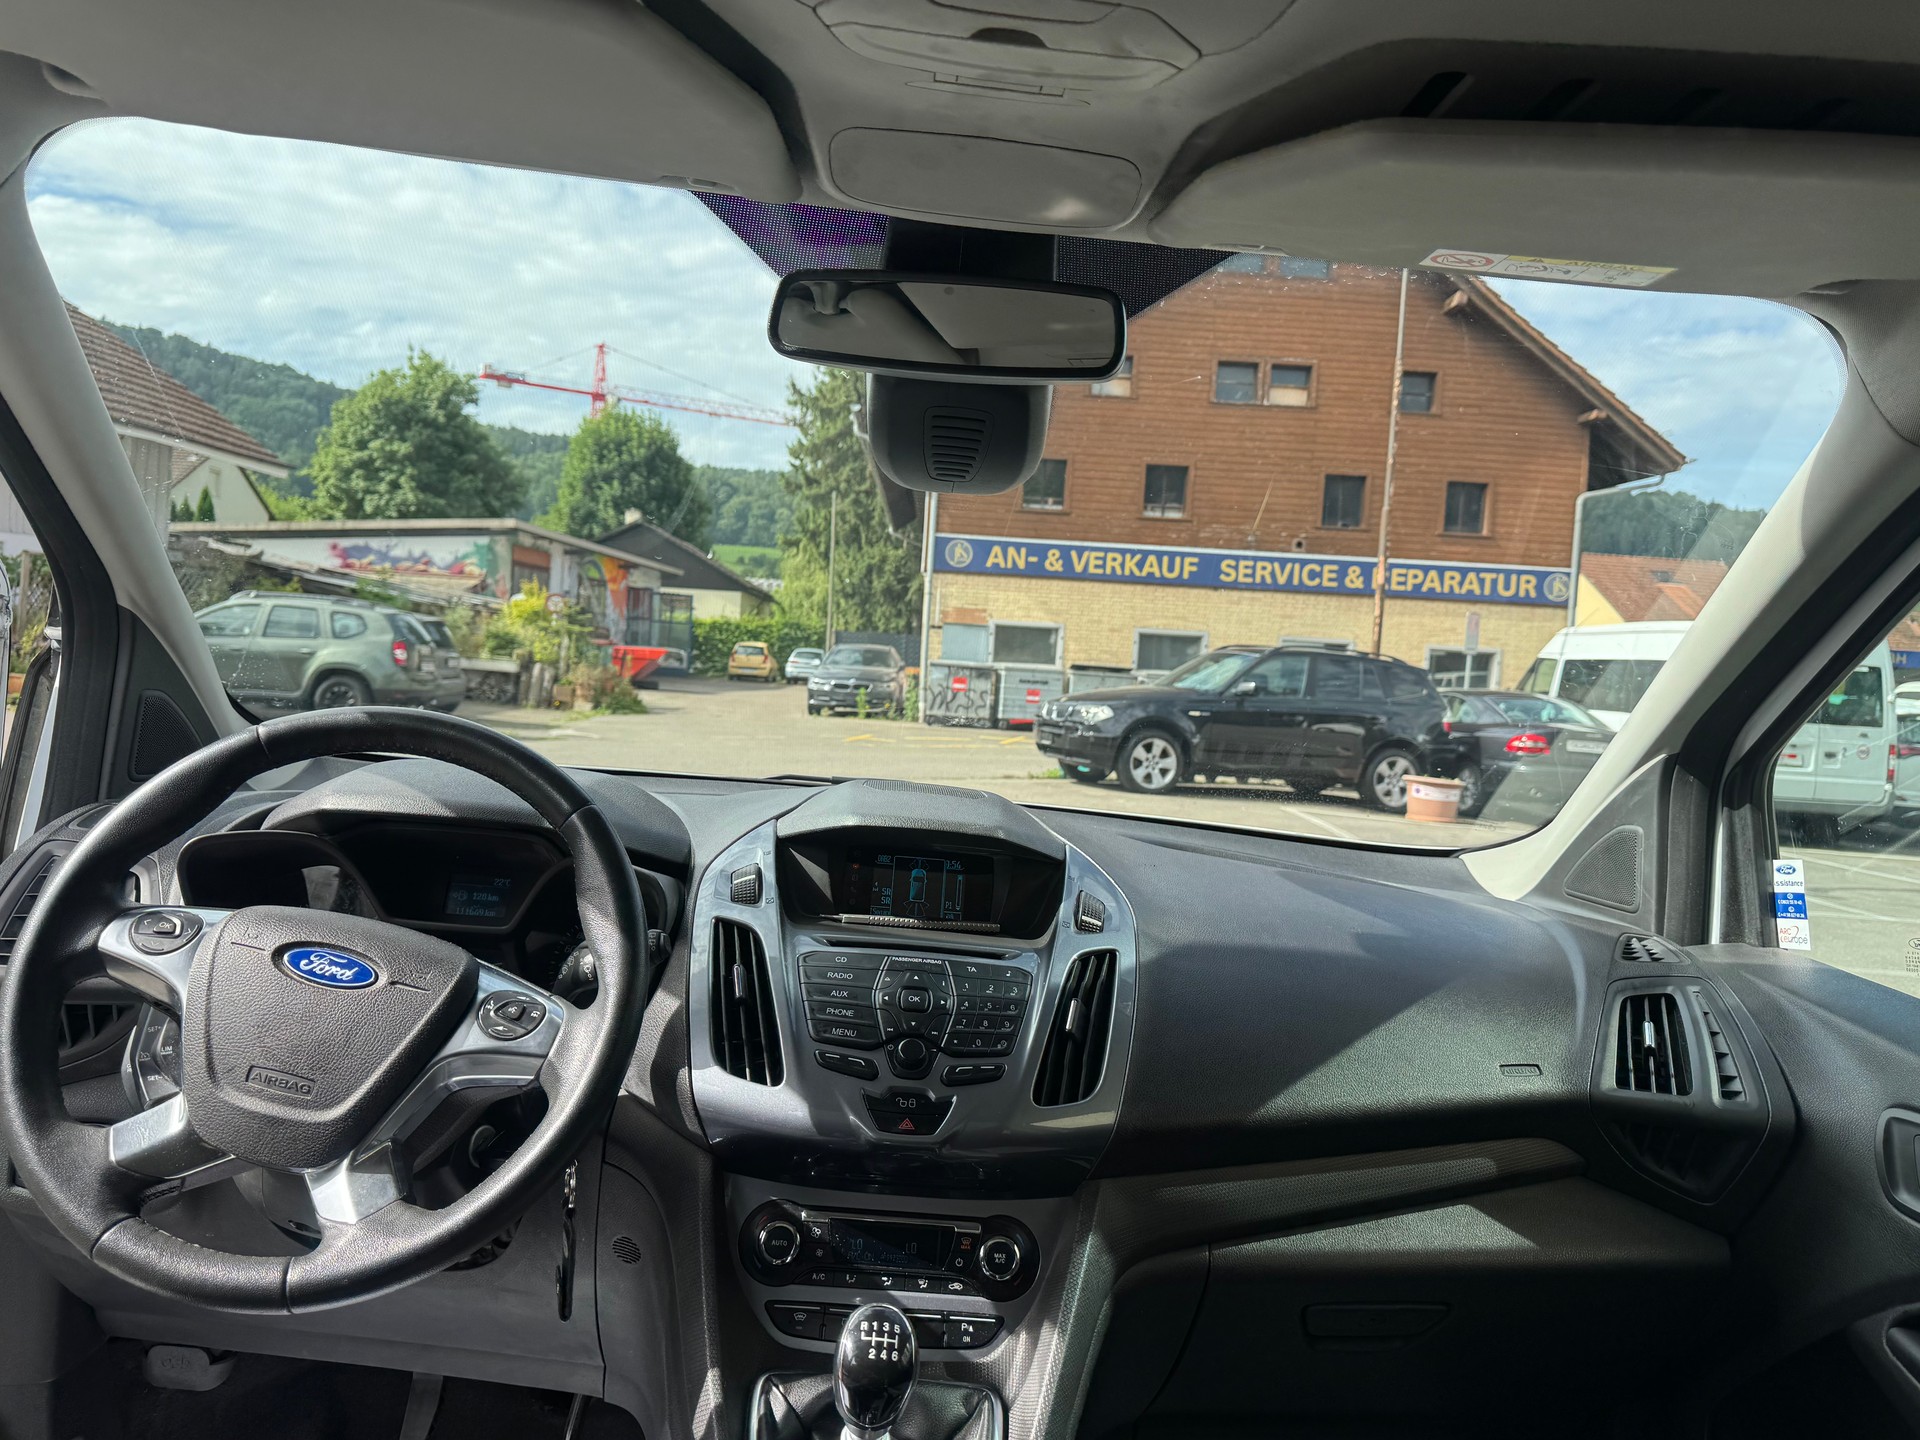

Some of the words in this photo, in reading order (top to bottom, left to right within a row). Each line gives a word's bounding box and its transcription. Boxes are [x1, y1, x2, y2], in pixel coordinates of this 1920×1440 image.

[985, 545, 1038, 570] AN-
[1044, 548, 1064, 572] &
[1070, 550, 1199, 580] VERKAUF
[1219, 558, 1339, 588] SERVICE
[1345, 565, 1365, 590] &
[159, 921, 173, 929] OK
[892, 956, 923, 964] PASSENGER
[299, 952, 359, 981] Ford
[827, 971, 853, 981] RADIO
[830, 989, 849, 998] AUX
[908, 995, 921, 1003] OK
[826, 1007, 855, 1017] PHONE
[831, 1027, 857, 1038] MENU
[249, 1071, 312, 1094] AIRBAG
[771, 1239, 788, 1247] AUTO
[811, 1272, 826, 1281] A/C
[860, 1320, 869, 1331] R
[882, 1321, 890, 1332] 3
[894, 1324, 901, 1334] 5
[868, 1348, 876, 1359] 2
[880, 1349, 888, 1360] 4
[891, 1351, 899, 1362] 6
